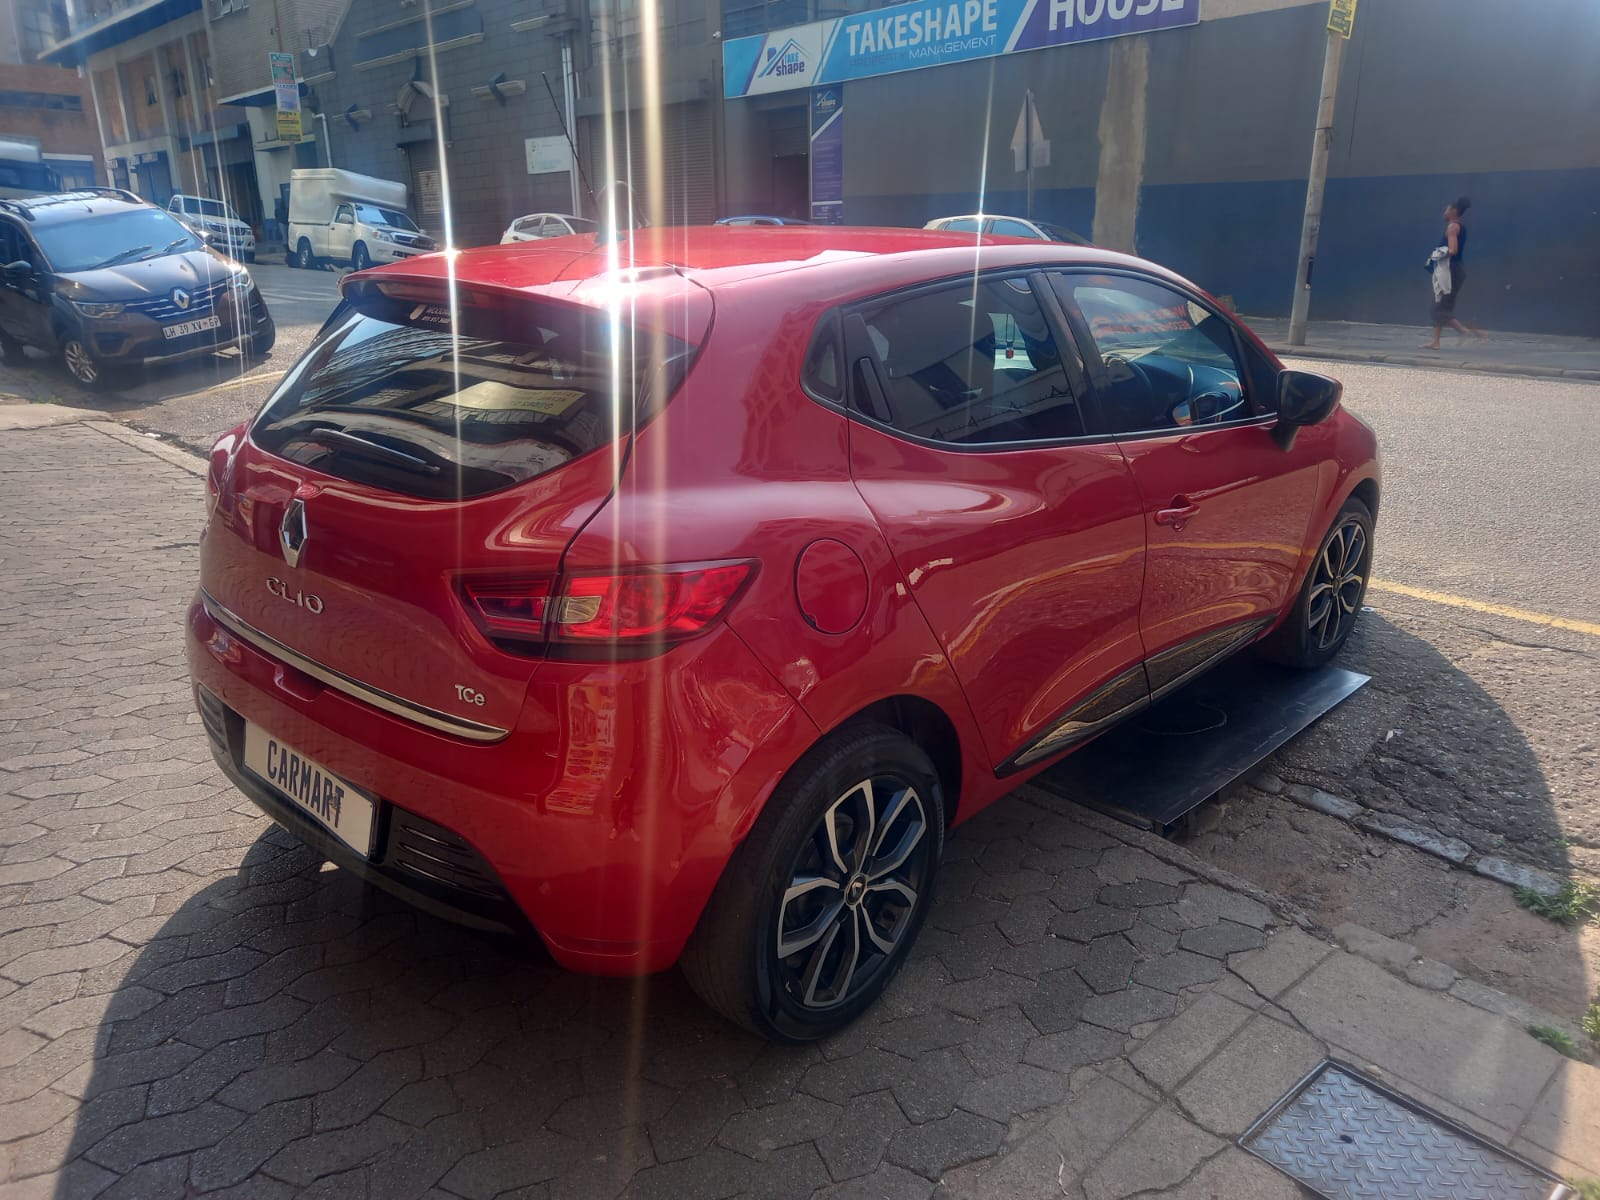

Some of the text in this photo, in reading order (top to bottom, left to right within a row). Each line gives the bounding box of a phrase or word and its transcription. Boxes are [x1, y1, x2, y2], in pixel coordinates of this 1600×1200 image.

[846, 0, 998, 57] TAKESHAPE
[909, 34, 997, 60] MANAGEMENT
[776, 59, 805, 77] shape
[265, 576, 325, 614] CLIO
[454, 684, 486, 707] TCe
[266, 739, 345, 828] CARMART
